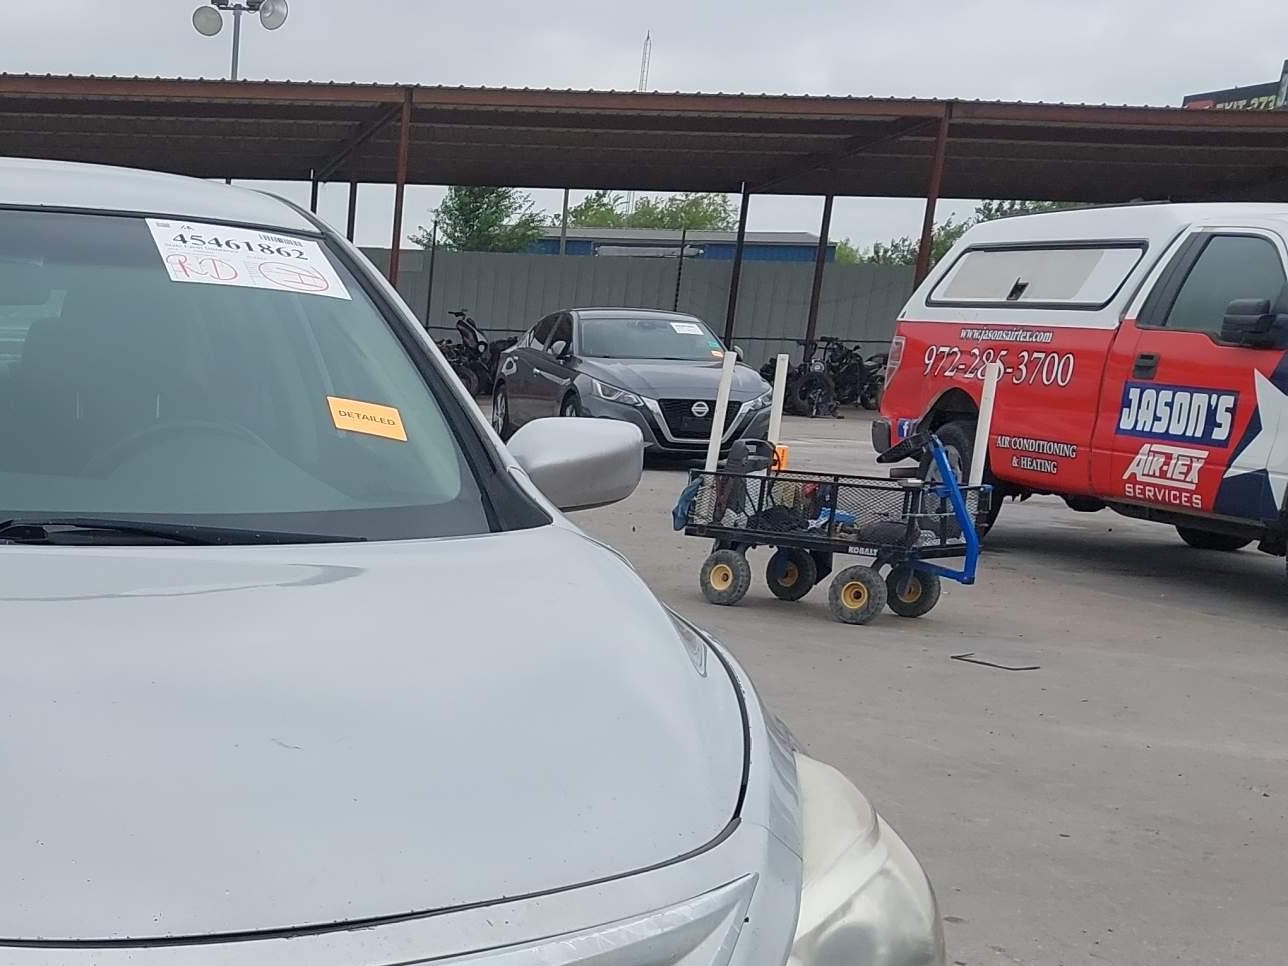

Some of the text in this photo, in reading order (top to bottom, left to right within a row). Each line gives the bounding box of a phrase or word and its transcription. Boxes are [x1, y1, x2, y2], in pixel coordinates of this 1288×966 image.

[172, 233, 309, 261] 45461862
[960, 327, 1053, 344] www.jasonsairtex.com
[924, 345, 1075, 387] 972-285-3700
[338, 410, 396, 426] DETAILED
[1119, 387, 1235, 441] JASON'S
[997, 435, 1077, 458] AIR CONDITIONING
[1012, 456, 1057, 474] & HEATING
[1122, 443, 1210, 490] AIR-TEX
[1124, 483, 1203, 508] SERVICES
[848, 545, 879, 556] KOBALT
